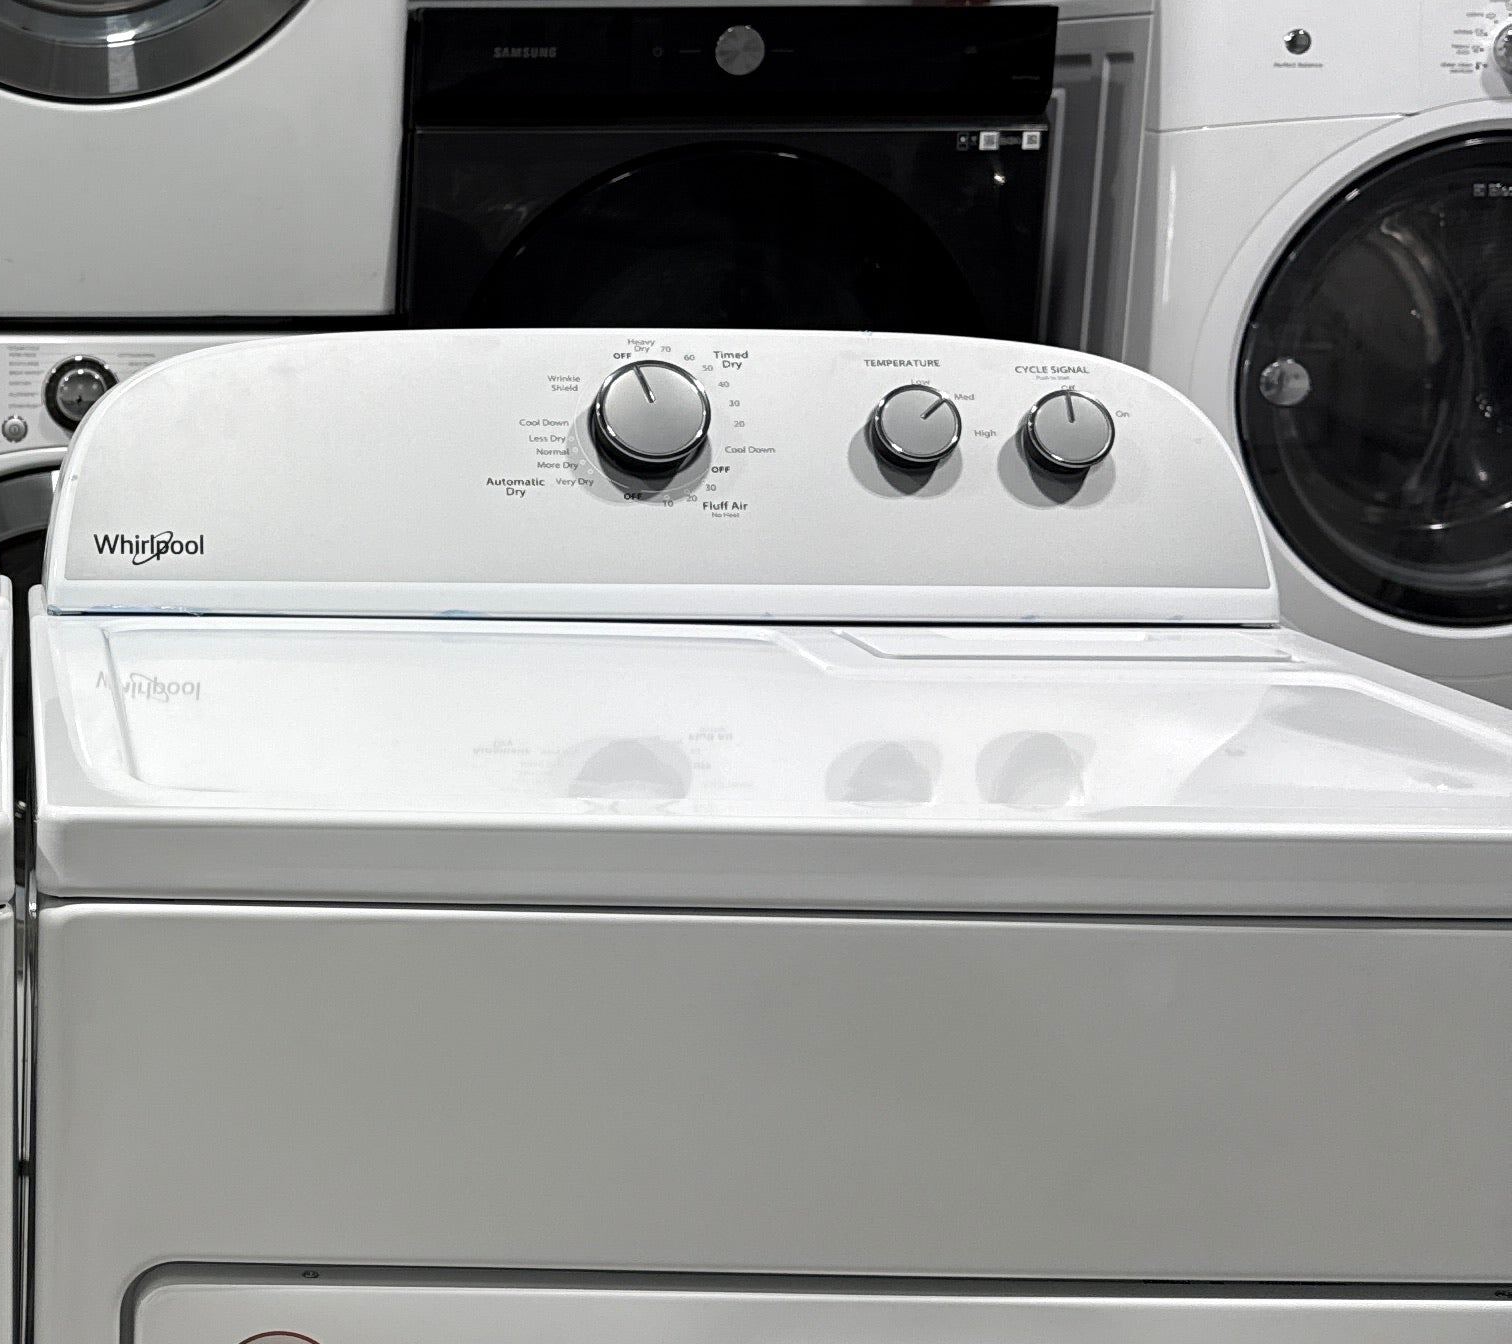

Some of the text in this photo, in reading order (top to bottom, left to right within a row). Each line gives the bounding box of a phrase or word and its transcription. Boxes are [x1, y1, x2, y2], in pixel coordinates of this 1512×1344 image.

[493, 47, 557, 58] SAMSUNG
[713, 350, 749, 359] Timed
[722, 360, 742, 370] Dry
[864, 359, 940, 367] TEMPERATURE
[1015, 366, 1090, 374] CYCLE SIGNAL
[954, 393, 975, 401] Med
[974, 429, 997, 438] High
[550, 435, 566, 444] Dry
[536, 448, 570, 456] Normal
[563, 462, 579, 471] Dry
[486, 477, 545, 486] Automatic
[556, 478, 594, 487] Very Dry
[506, 487, 526, 497] Dry
[623, 492, 642, 500] OFF
[703, 501, 748, 510] Fluff Air
[93, 531, 204, 565] Whirlpool
